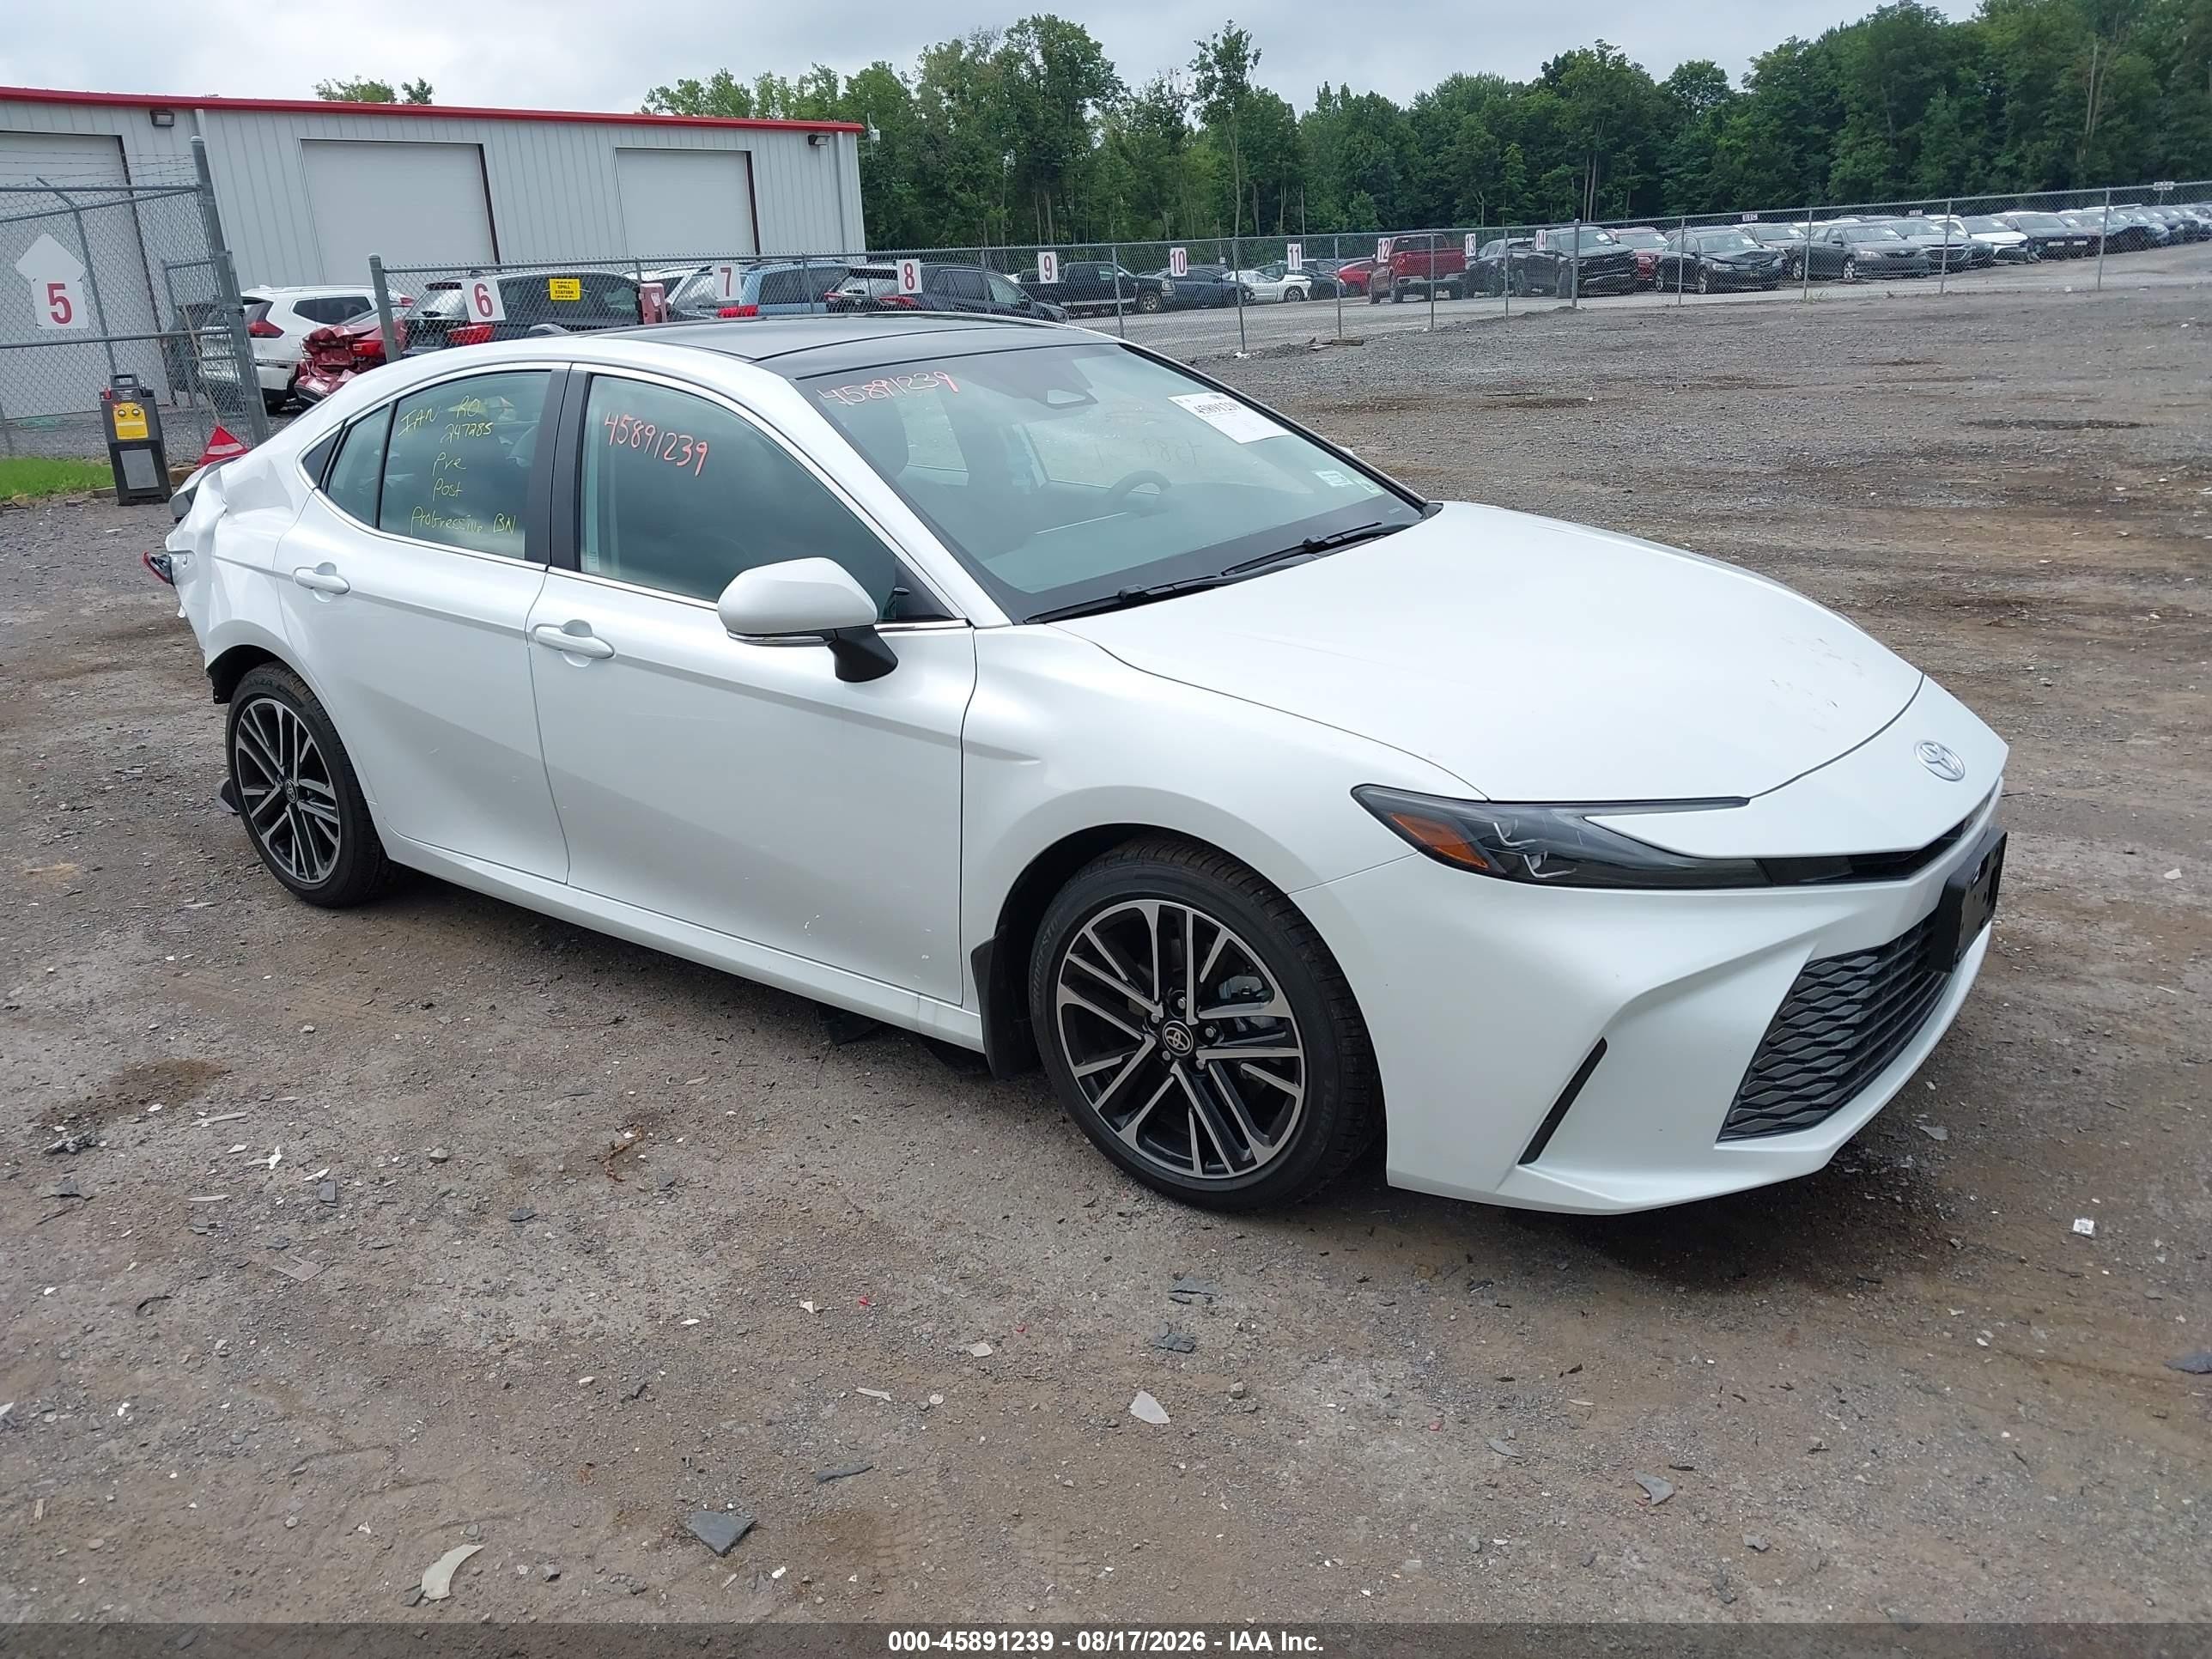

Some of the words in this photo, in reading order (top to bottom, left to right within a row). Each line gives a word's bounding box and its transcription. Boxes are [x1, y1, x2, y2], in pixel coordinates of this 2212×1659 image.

[1289, 246, 1300, 268] 11
[1378, 240, 1389, 260] 12
[1466, 234, 1475, 255] 13
[1043, 254, 1053, 281] 9
[1170, 250, 1186, 274] 10
[720, 267, 732, 297] 7
[903, 262, 915, 291] 8
[46, 283, 72, 325] 5
[473, 283, 494, 318] 6
[817, 371, 960, 406] 45891239
[440, 422, 494, 444] 247285
[604, 411, 708, 477] 45891239
[433, 477, 463, 501] Post
